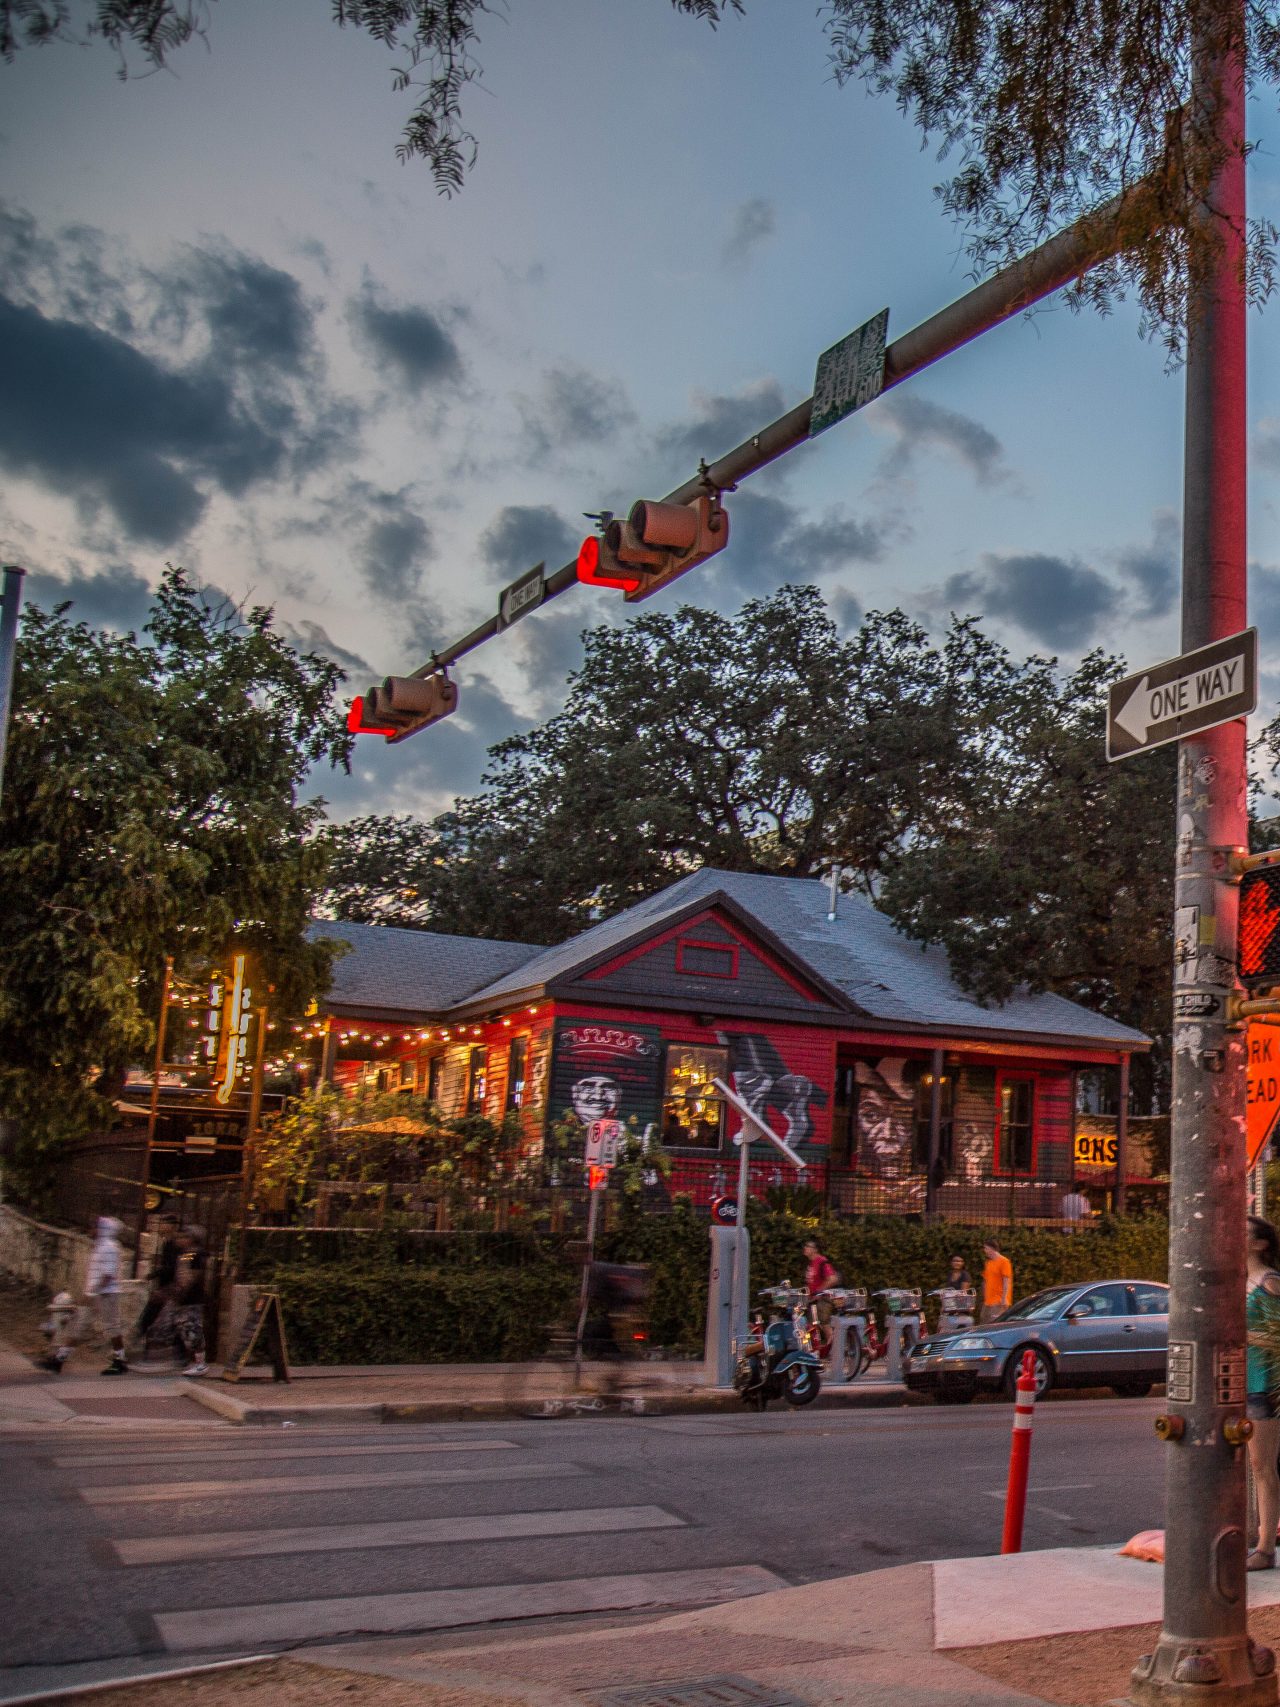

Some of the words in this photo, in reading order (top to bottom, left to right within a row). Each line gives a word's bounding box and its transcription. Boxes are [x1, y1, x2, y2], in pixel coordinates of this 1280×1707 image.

[1150, 680, 1189, 720] ONE
[1196, 661, 1238, 704] WAY
[1251, 1038, 1273, 1063] RK
[1247, 1077, 1277, 1103] EAD
